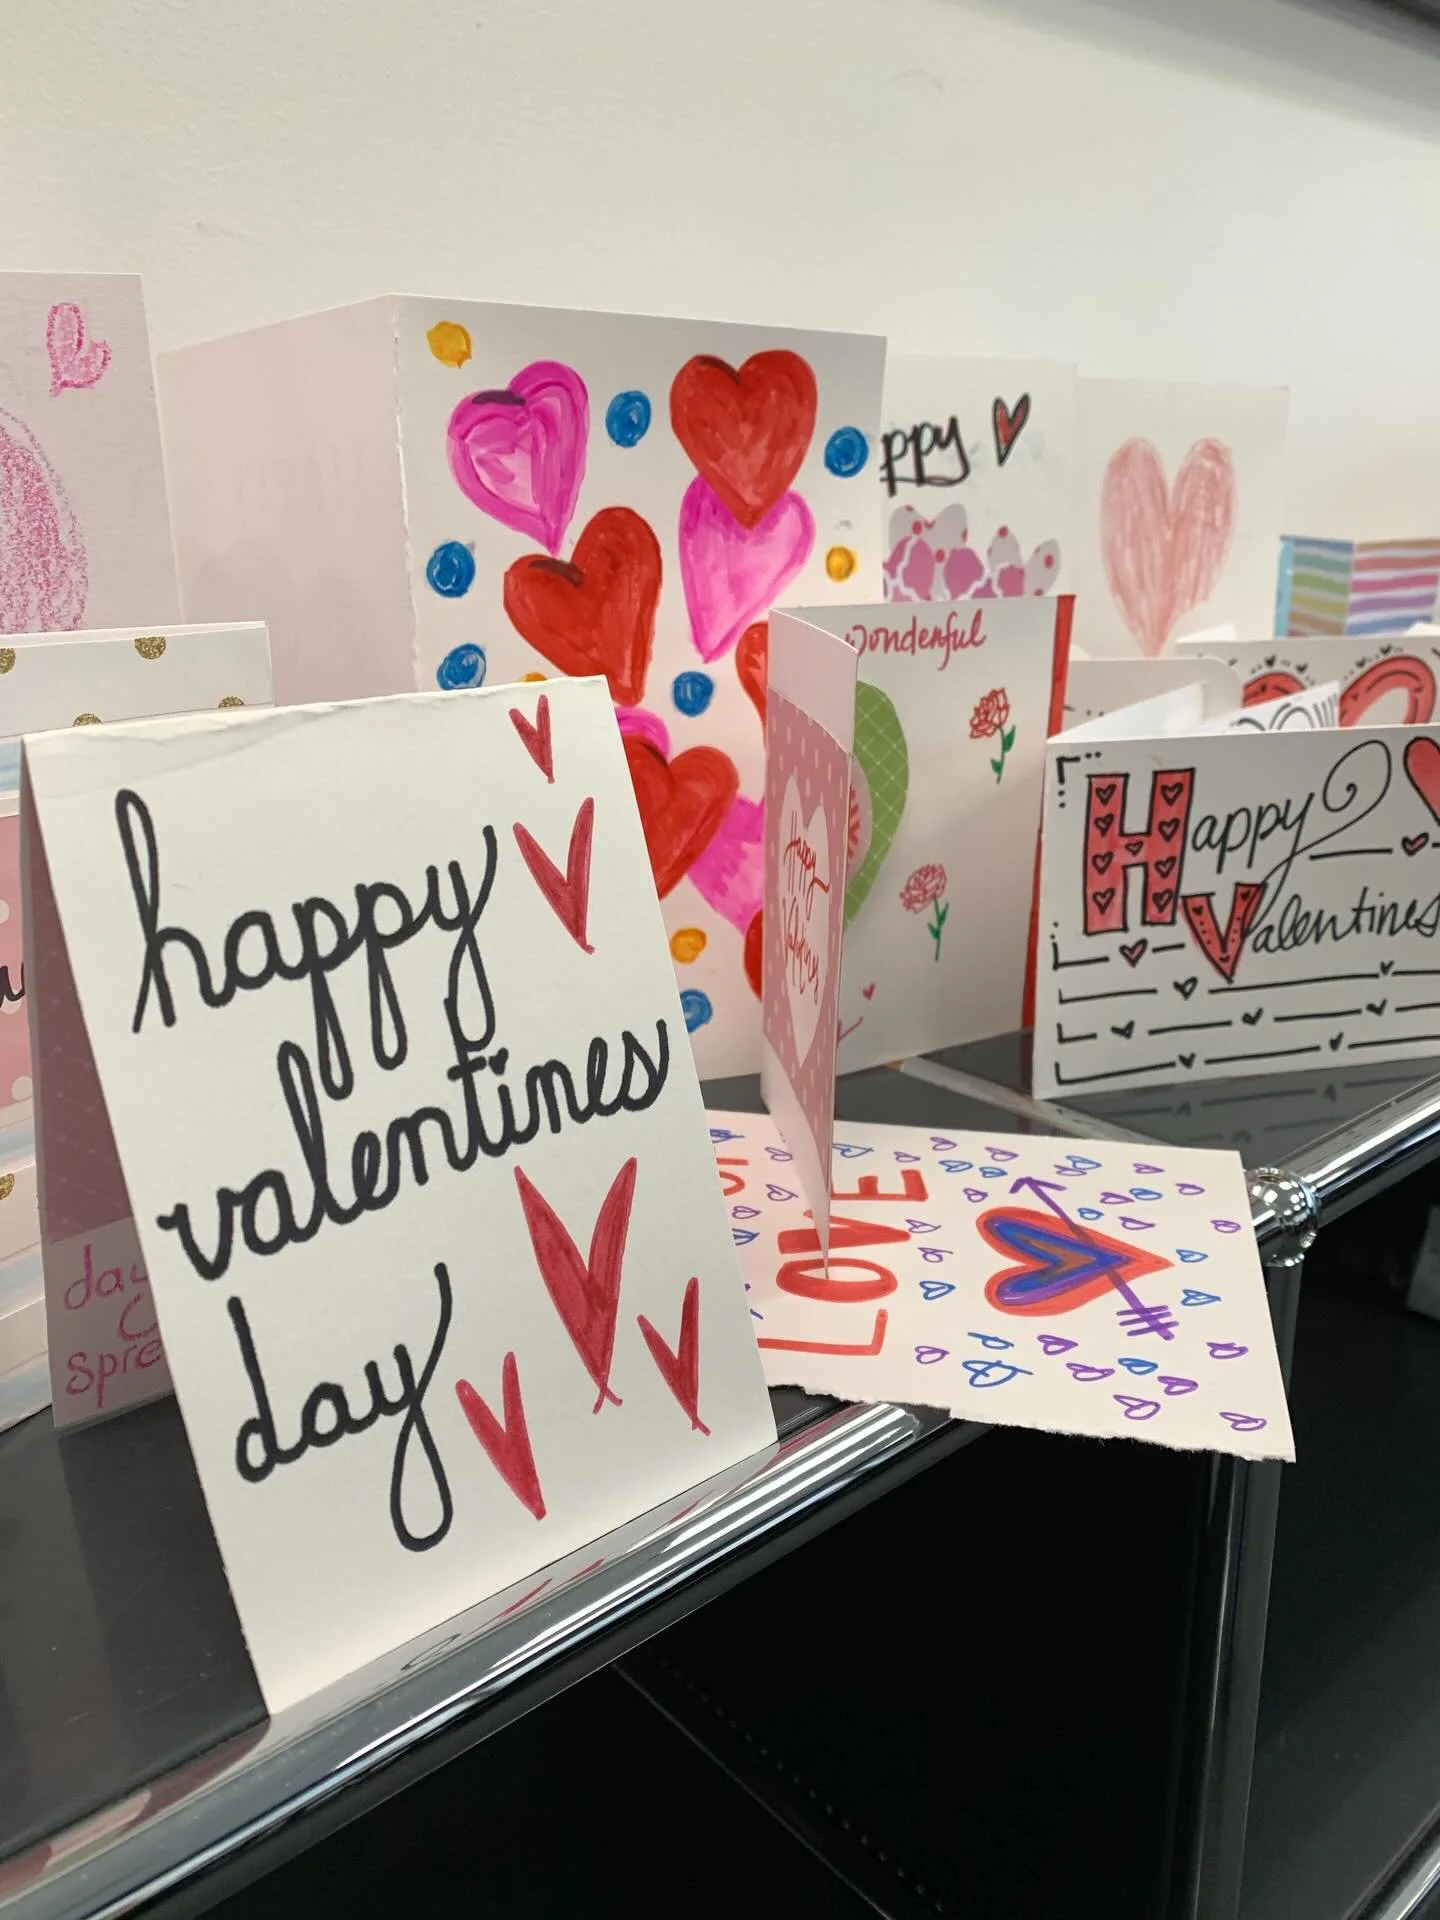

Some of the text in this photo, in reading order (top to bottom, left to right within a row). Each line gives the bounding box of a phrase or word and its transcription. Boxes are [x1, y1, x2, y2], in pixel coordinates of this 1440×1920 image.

[880, 414, 971, 498] ppy
[115, 789, 498, 1100] happy
[1083, 740, 1392, 937] Happy
[157, 1018, 670, 1280] valentines
[228, 1261, 453, 1553] day
